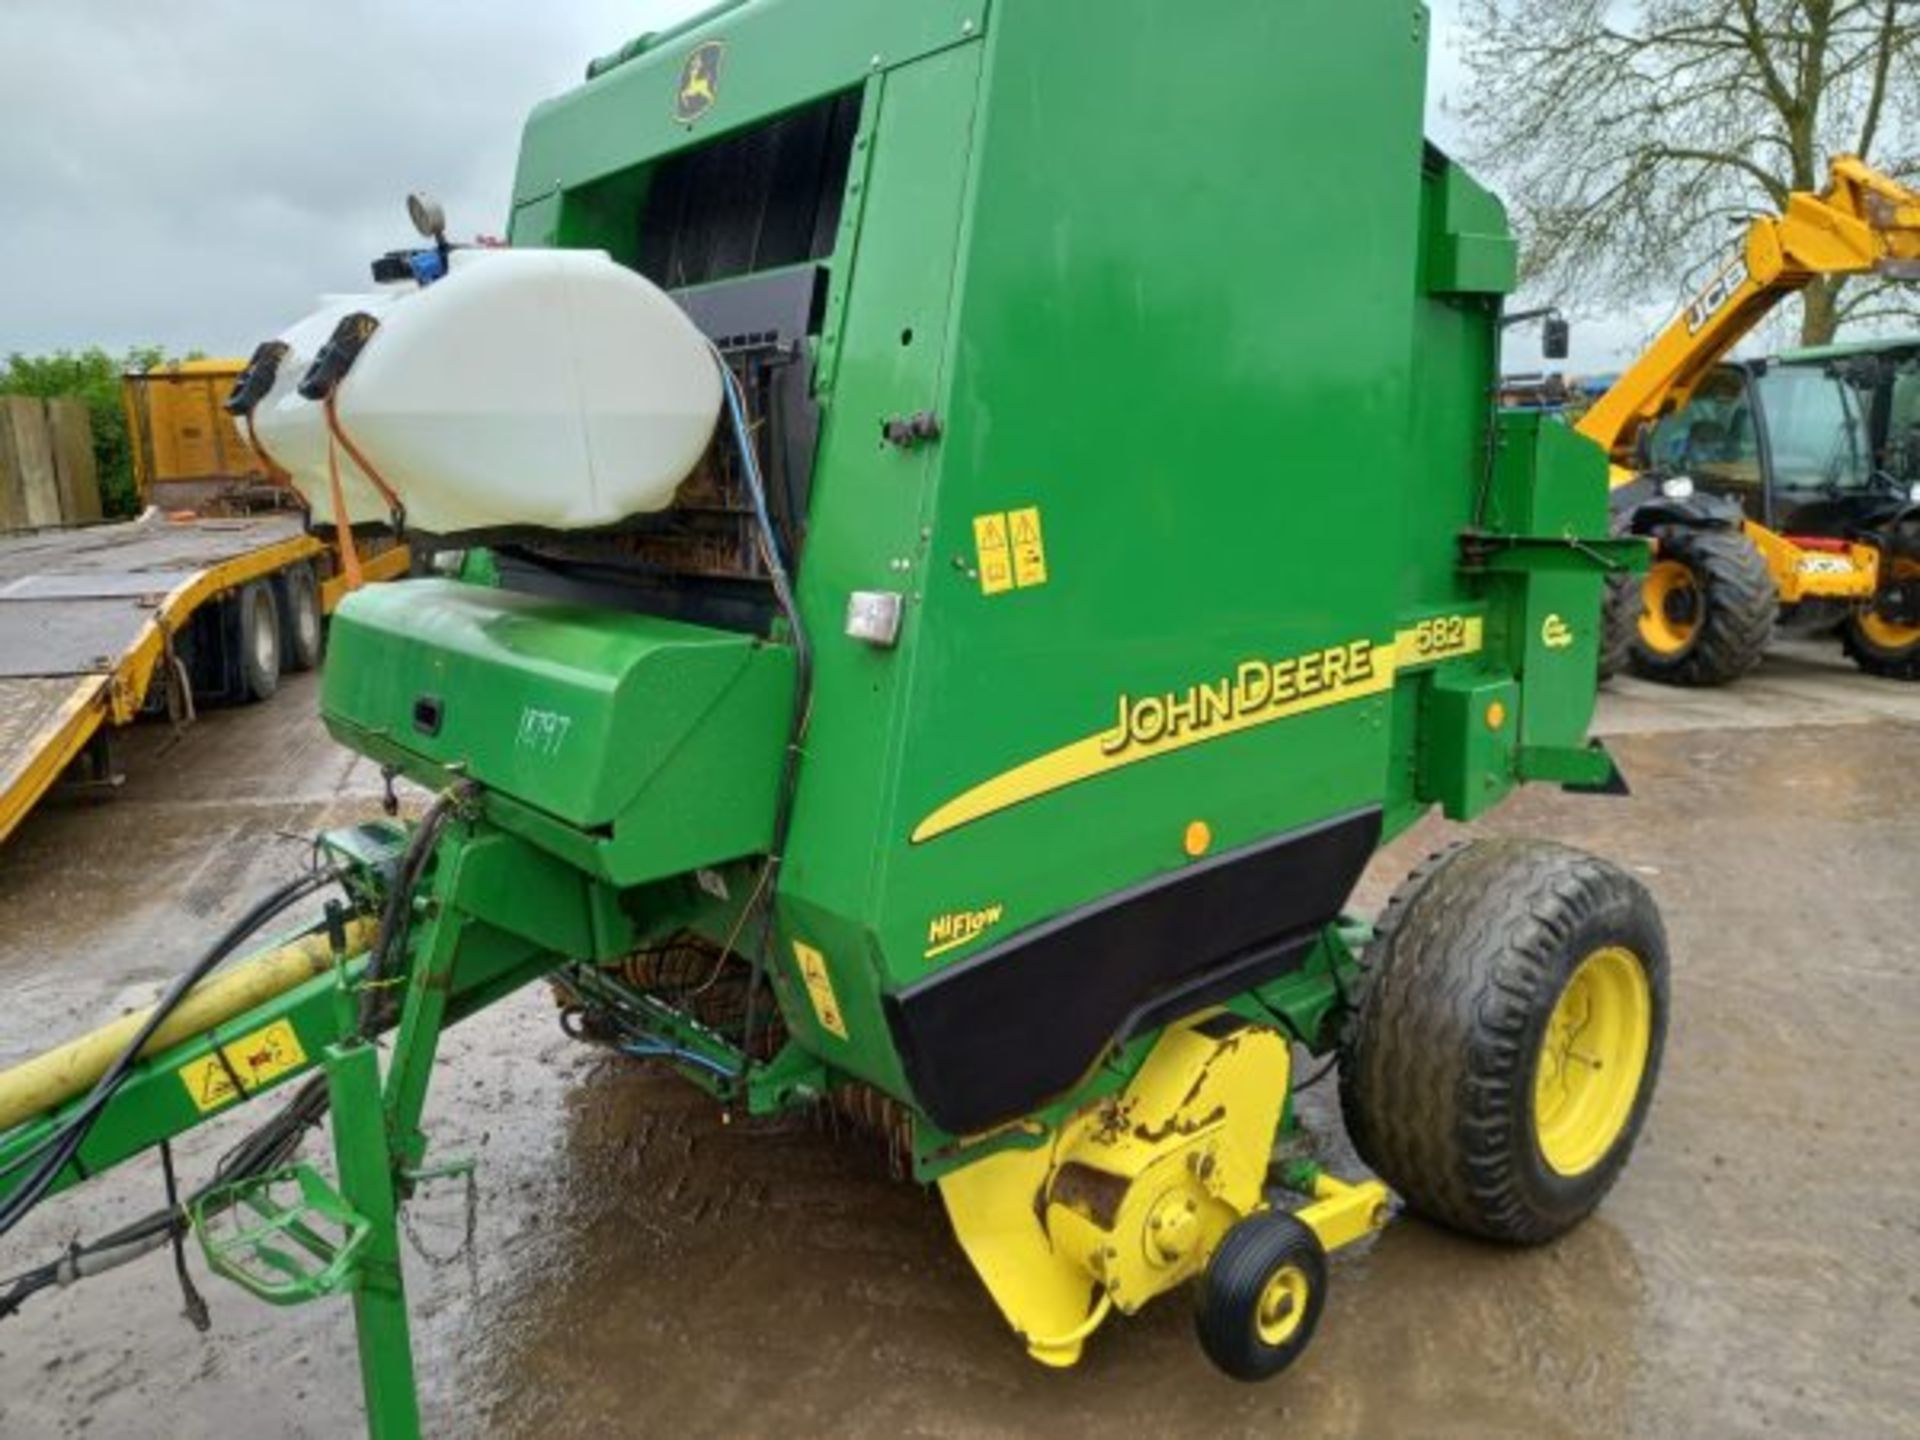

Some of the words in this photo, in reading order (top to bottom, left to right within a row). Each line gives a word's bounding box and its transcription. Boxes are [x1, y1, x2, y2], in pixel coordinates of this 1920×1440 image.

[1687, 260, 1748, 333] JCB
[1416, 614, 1466, 654] 582
[1101, 676, 1234, 755] JOHN
[1236, 638, 1373, 715] DEERE
